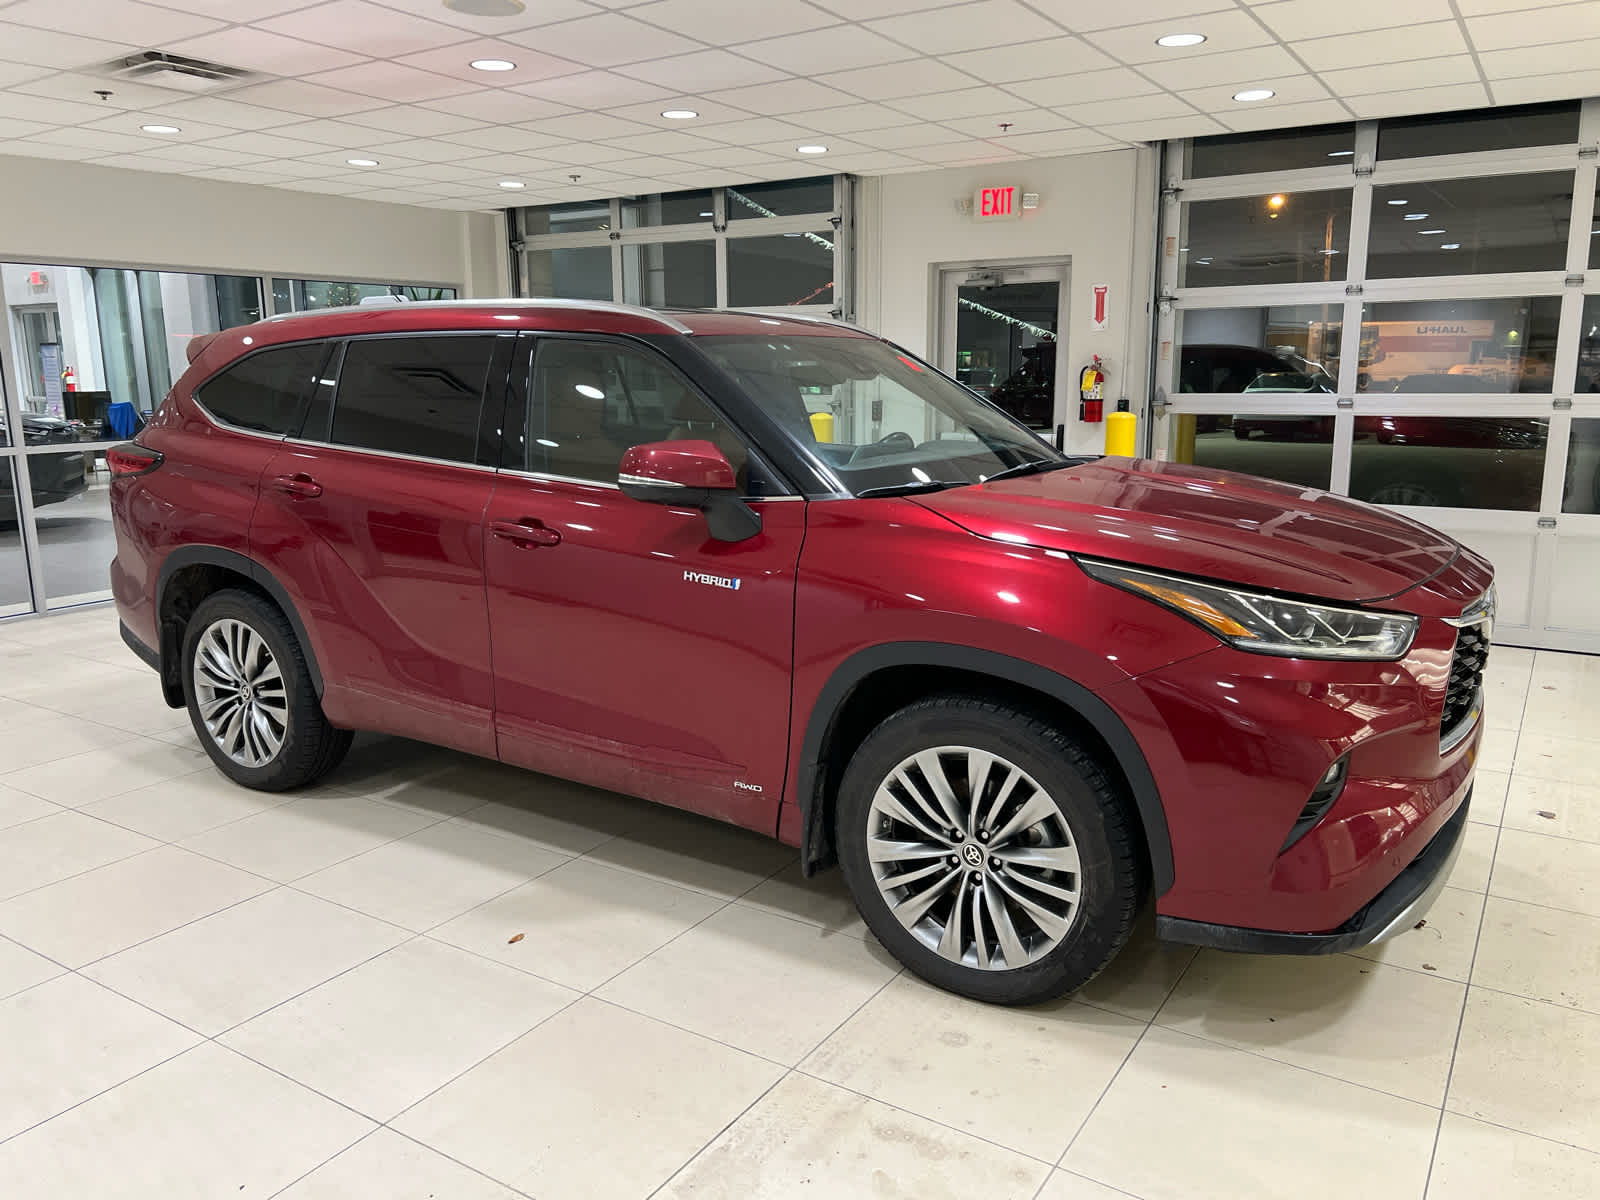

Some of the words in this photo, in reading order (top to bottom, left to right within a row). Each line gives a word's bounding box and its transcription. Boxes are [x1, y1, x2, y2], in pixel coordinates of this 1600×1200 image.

[981, 187, 1014, 216] EXIT
[1416, 325, 1467, 334] U-HAUL
[683, 570, 732, 589] HYBRID
[734, 781, 762, 792] AWD
